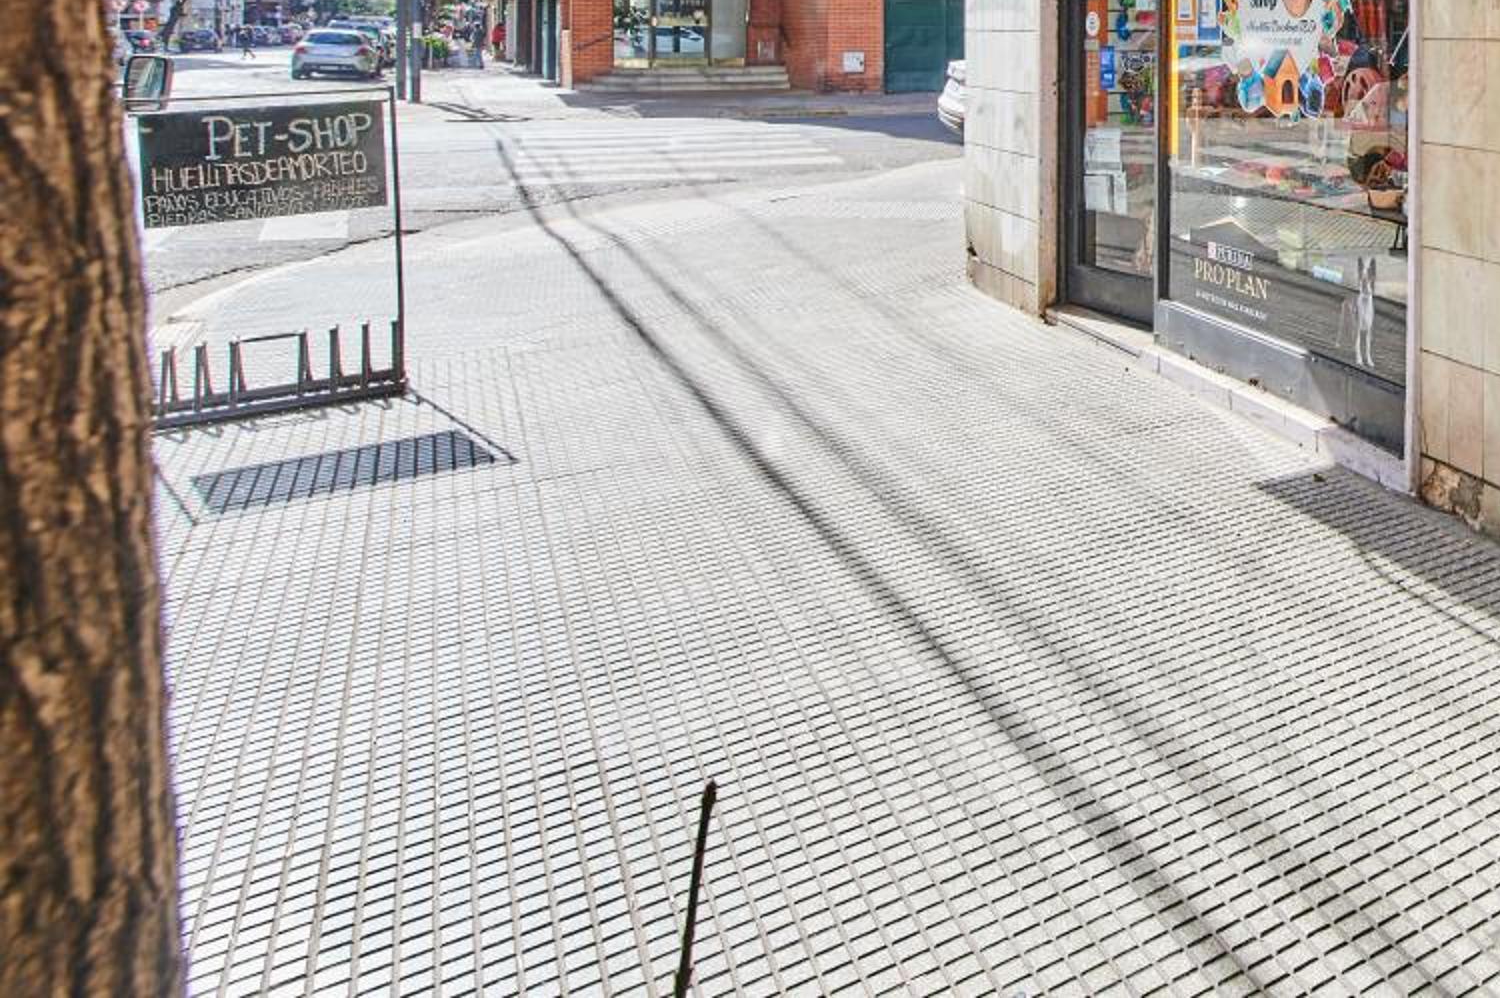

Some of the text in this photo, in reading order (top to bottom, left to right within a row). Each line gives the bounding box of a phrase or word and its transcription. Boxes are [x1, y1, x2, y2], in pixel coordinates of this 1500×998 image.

[201, 111, 373, 161] PET-SHOP
[1194, 257, 1225, 285] PRO
[1226, 266, 1267, 299] PLAN
